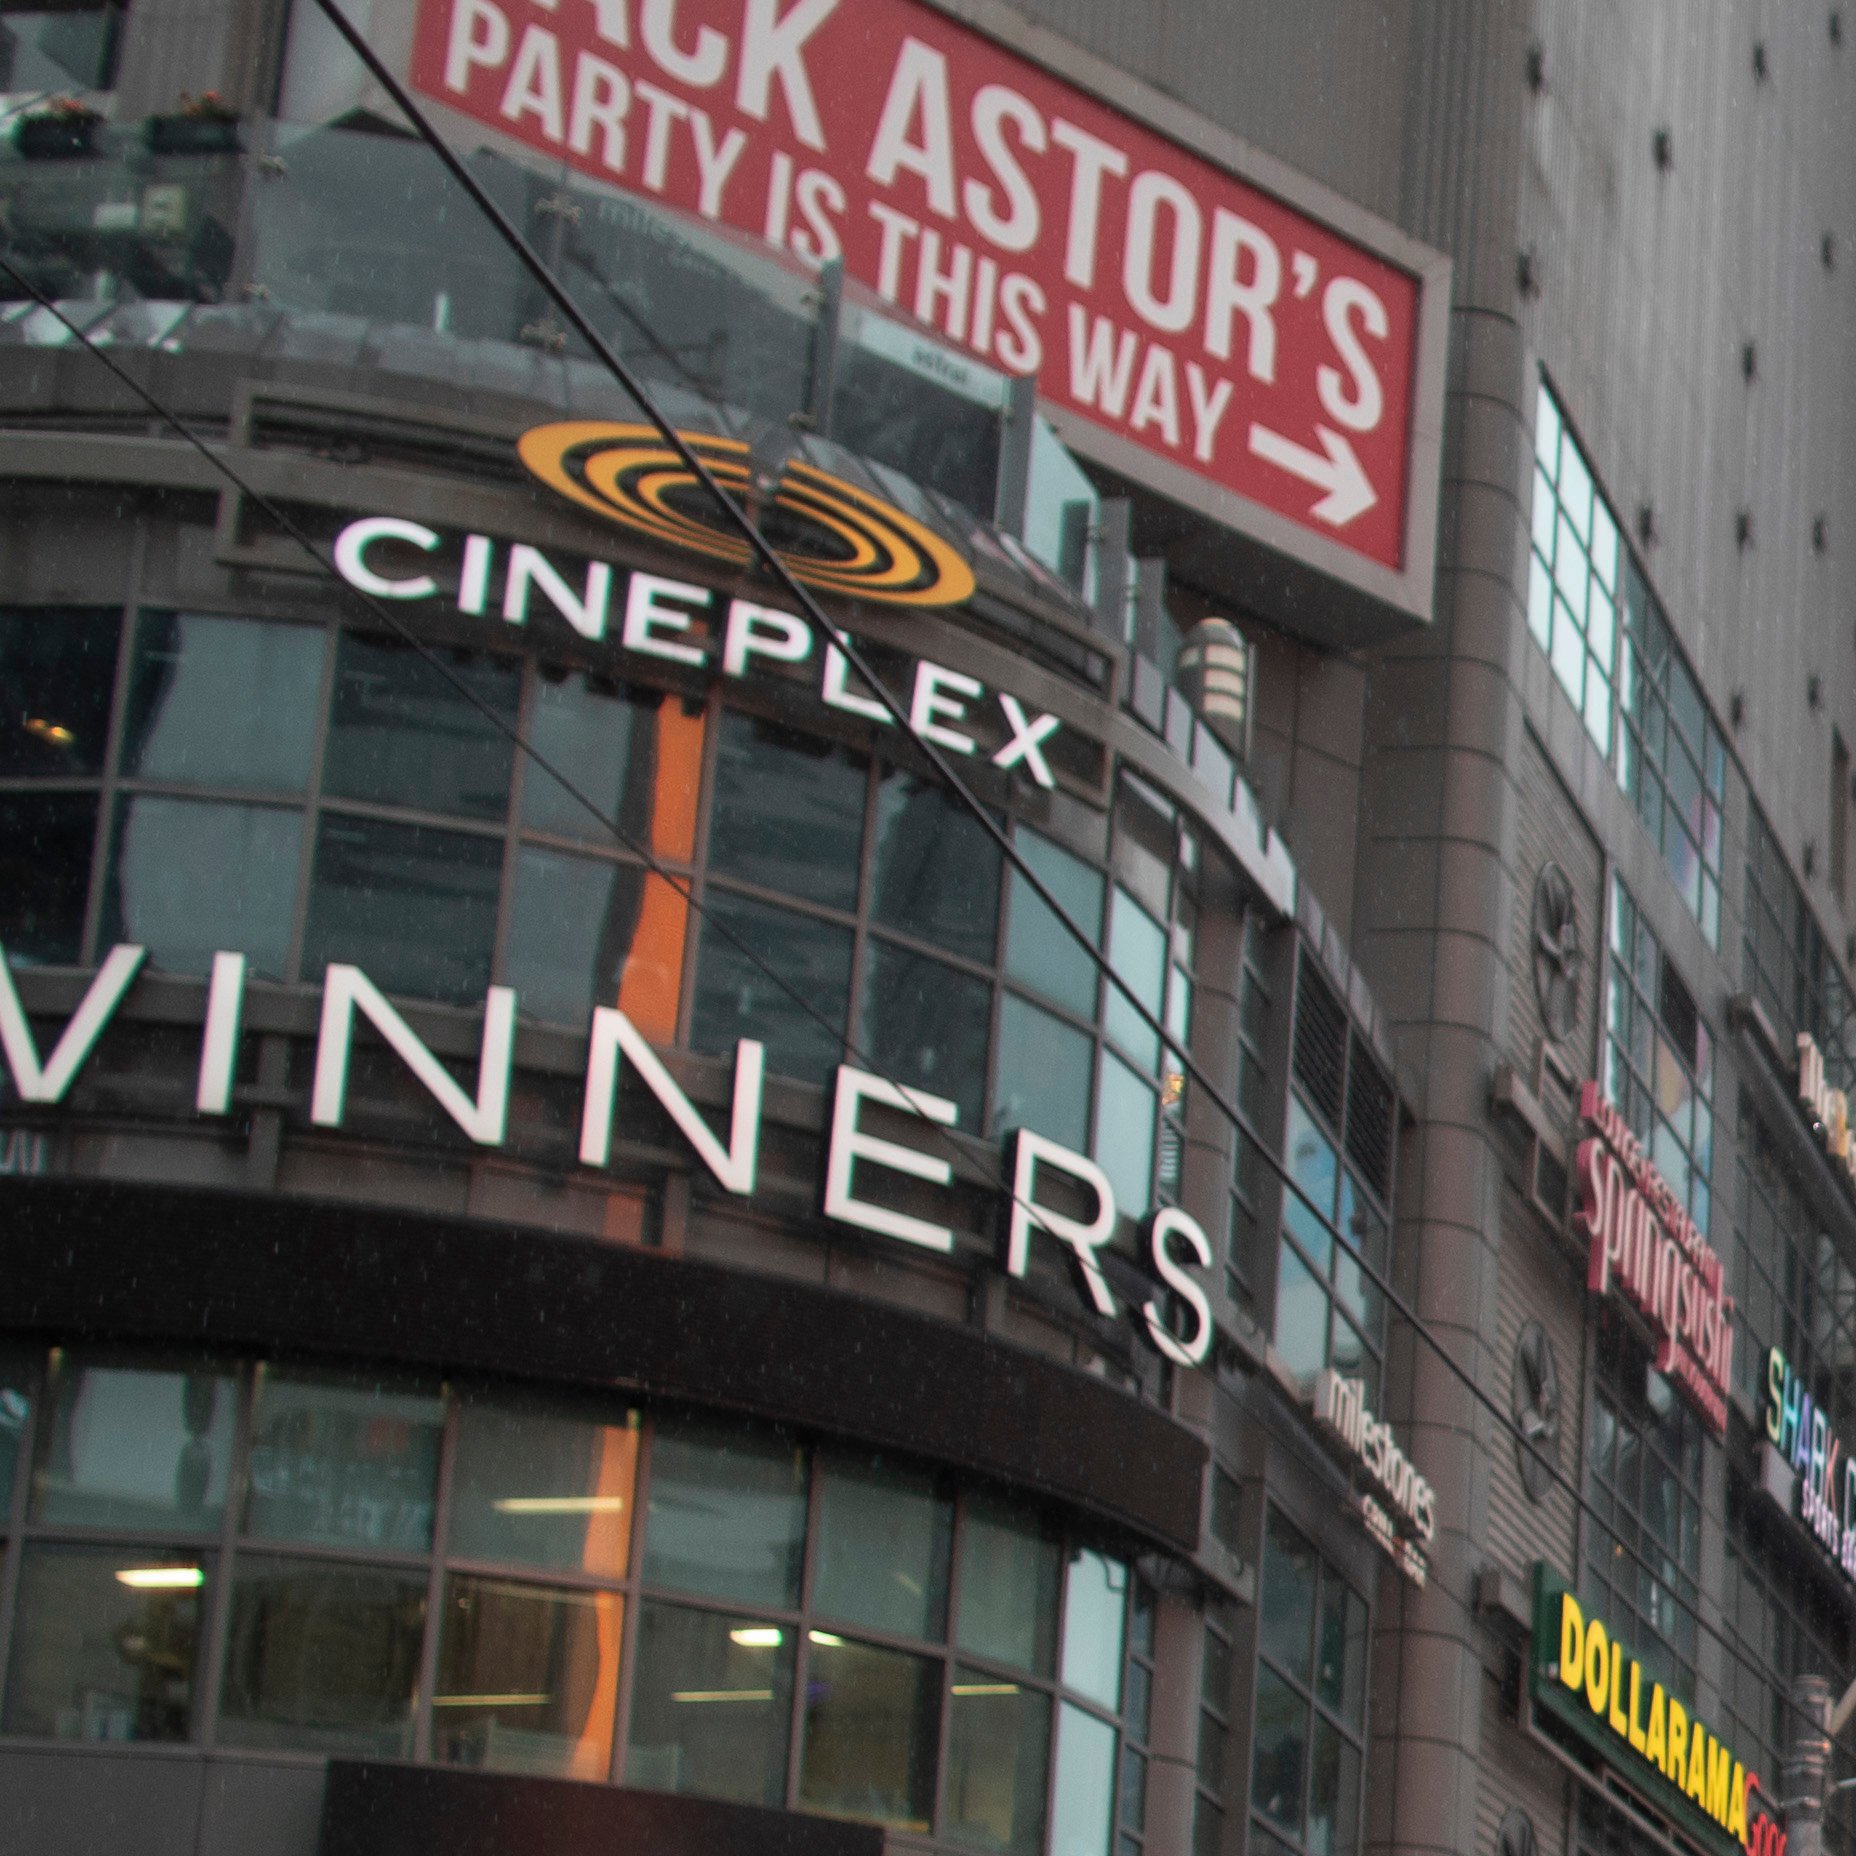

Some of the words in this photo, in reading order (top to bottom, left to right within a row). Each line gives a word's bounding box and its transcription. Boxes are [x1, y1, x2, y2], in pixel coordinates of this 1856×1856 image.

[445, 0, 747, 221] PARTY
[764, 149, 846, 278] IS
[868, 199, 1048, 374] THIS
[1066, 301, 1233, 464] WAY
[866, 35, 1390, 433] ASTOR'S
[334, 517, 1061, 787] CINEPLEX
[1766, 1346, 1841, 1520] SHARK
[1557, 1591, 1749, 1847] DOLLARAMA
